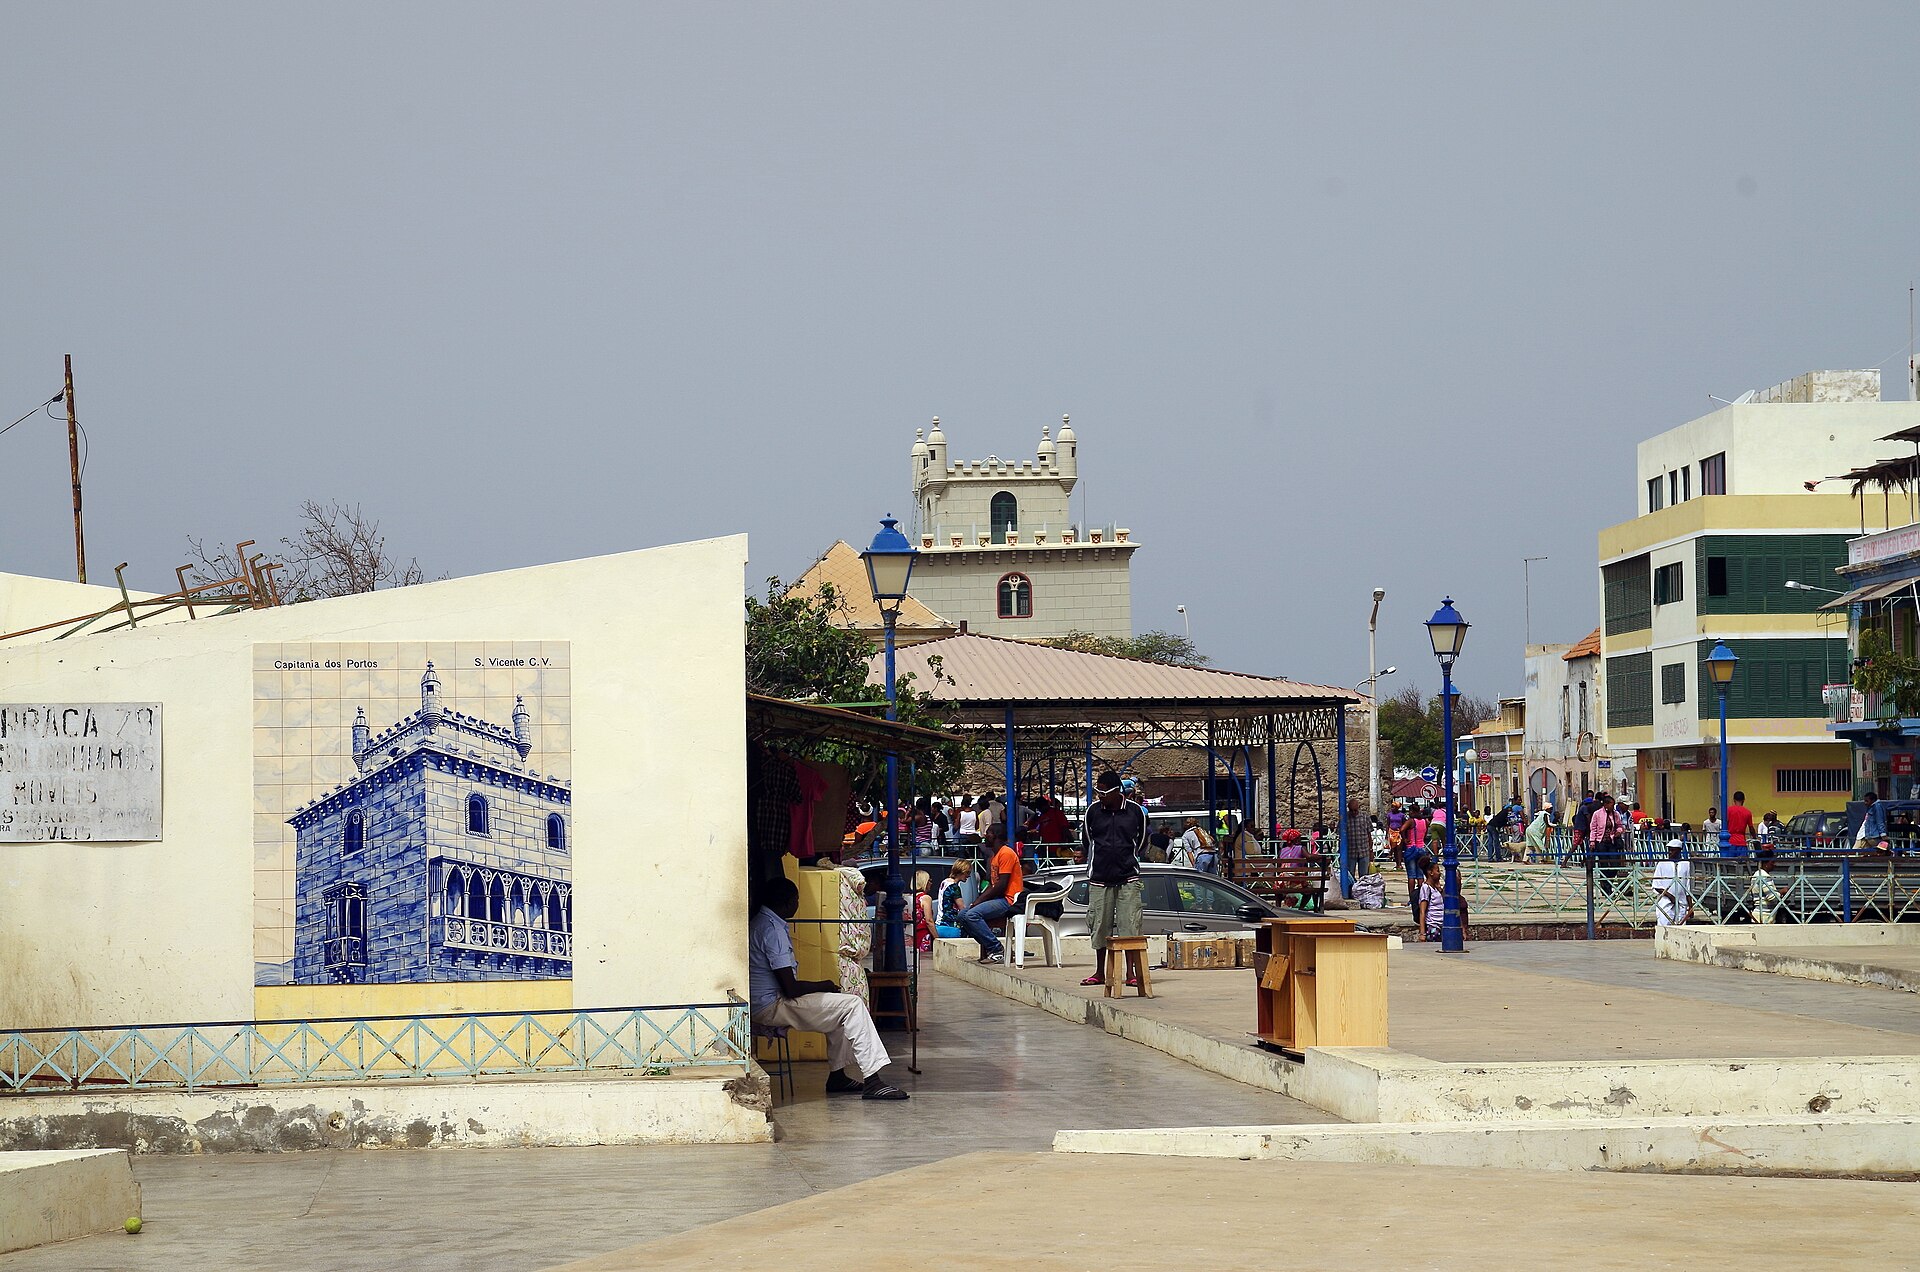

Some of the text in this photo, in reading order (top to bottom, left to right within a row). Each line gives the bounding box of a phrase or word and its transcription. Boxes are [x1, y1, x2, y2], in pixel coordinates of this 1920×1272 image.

[274, 659, 378, 670] Capitania dos Portos
[474, 657, 484, 666] S.
[488, 657, 525, 666] Vicente
